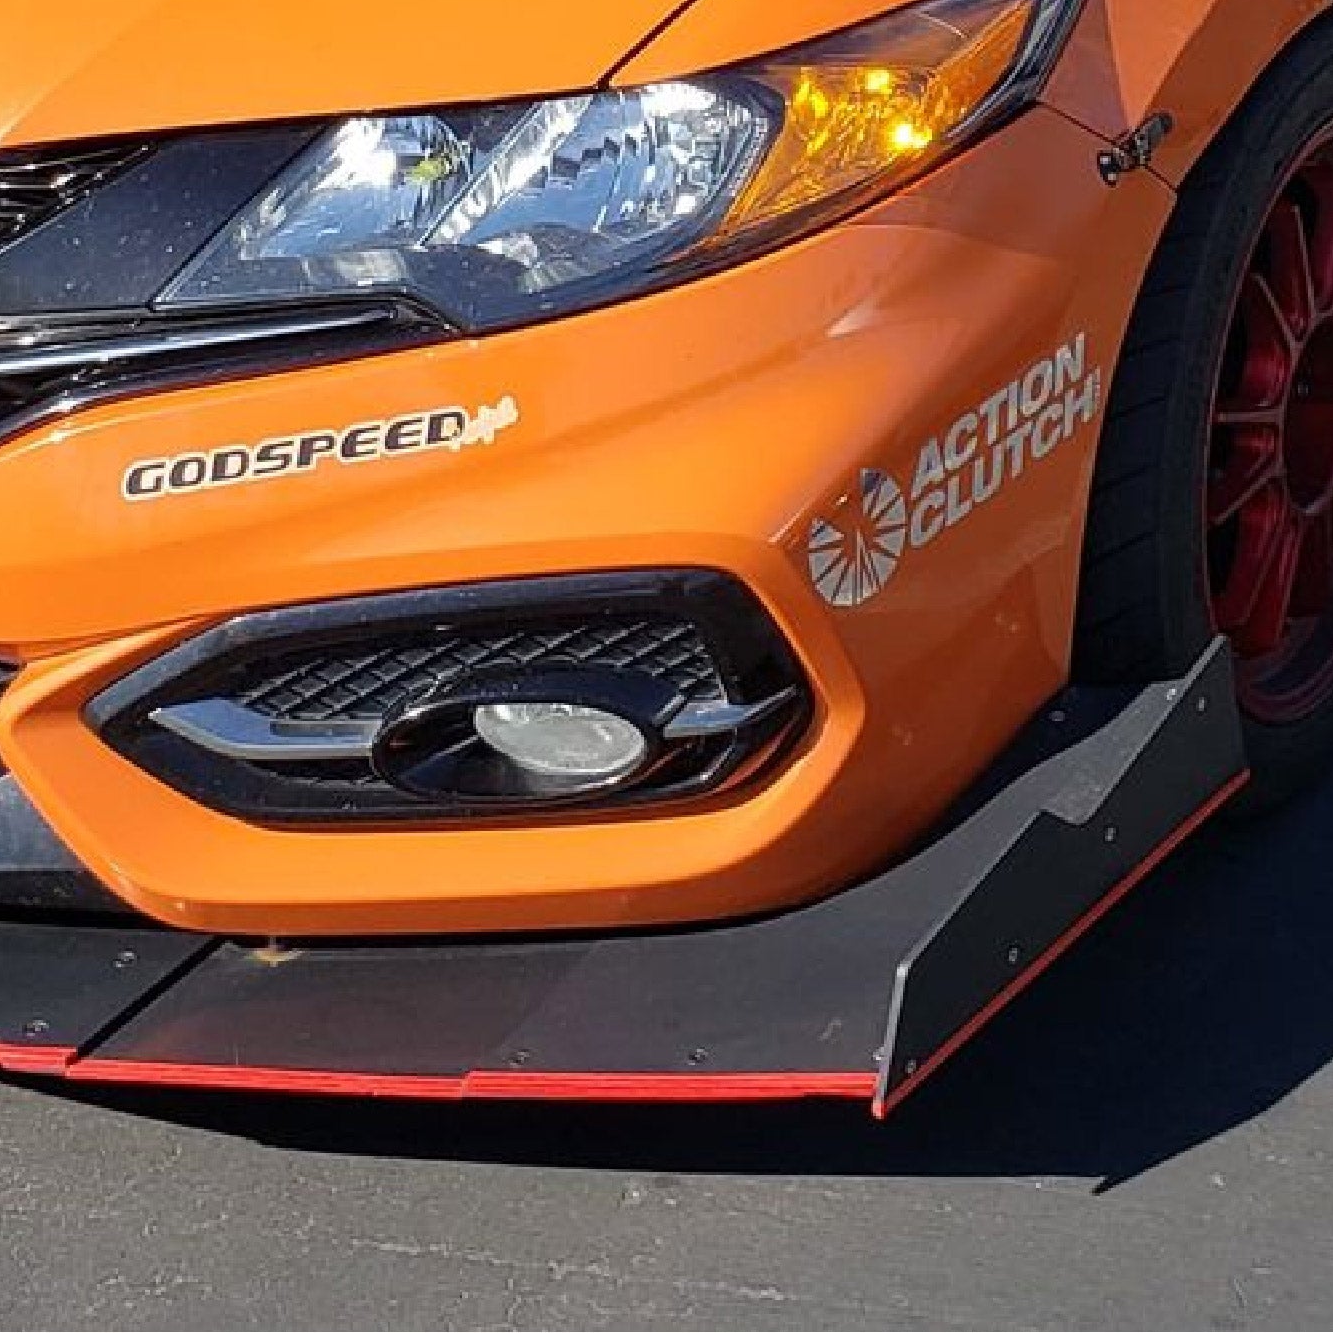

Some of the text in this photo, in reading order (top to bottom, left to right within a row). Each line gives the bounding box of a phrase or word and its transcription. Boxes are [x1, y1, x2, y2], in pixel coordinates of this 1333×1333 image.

[123, 408, 468, 498] GODSPEED
[909, 369, 1098, 549] CLUTCH
[911, 331, 1085, 499] ACTION
